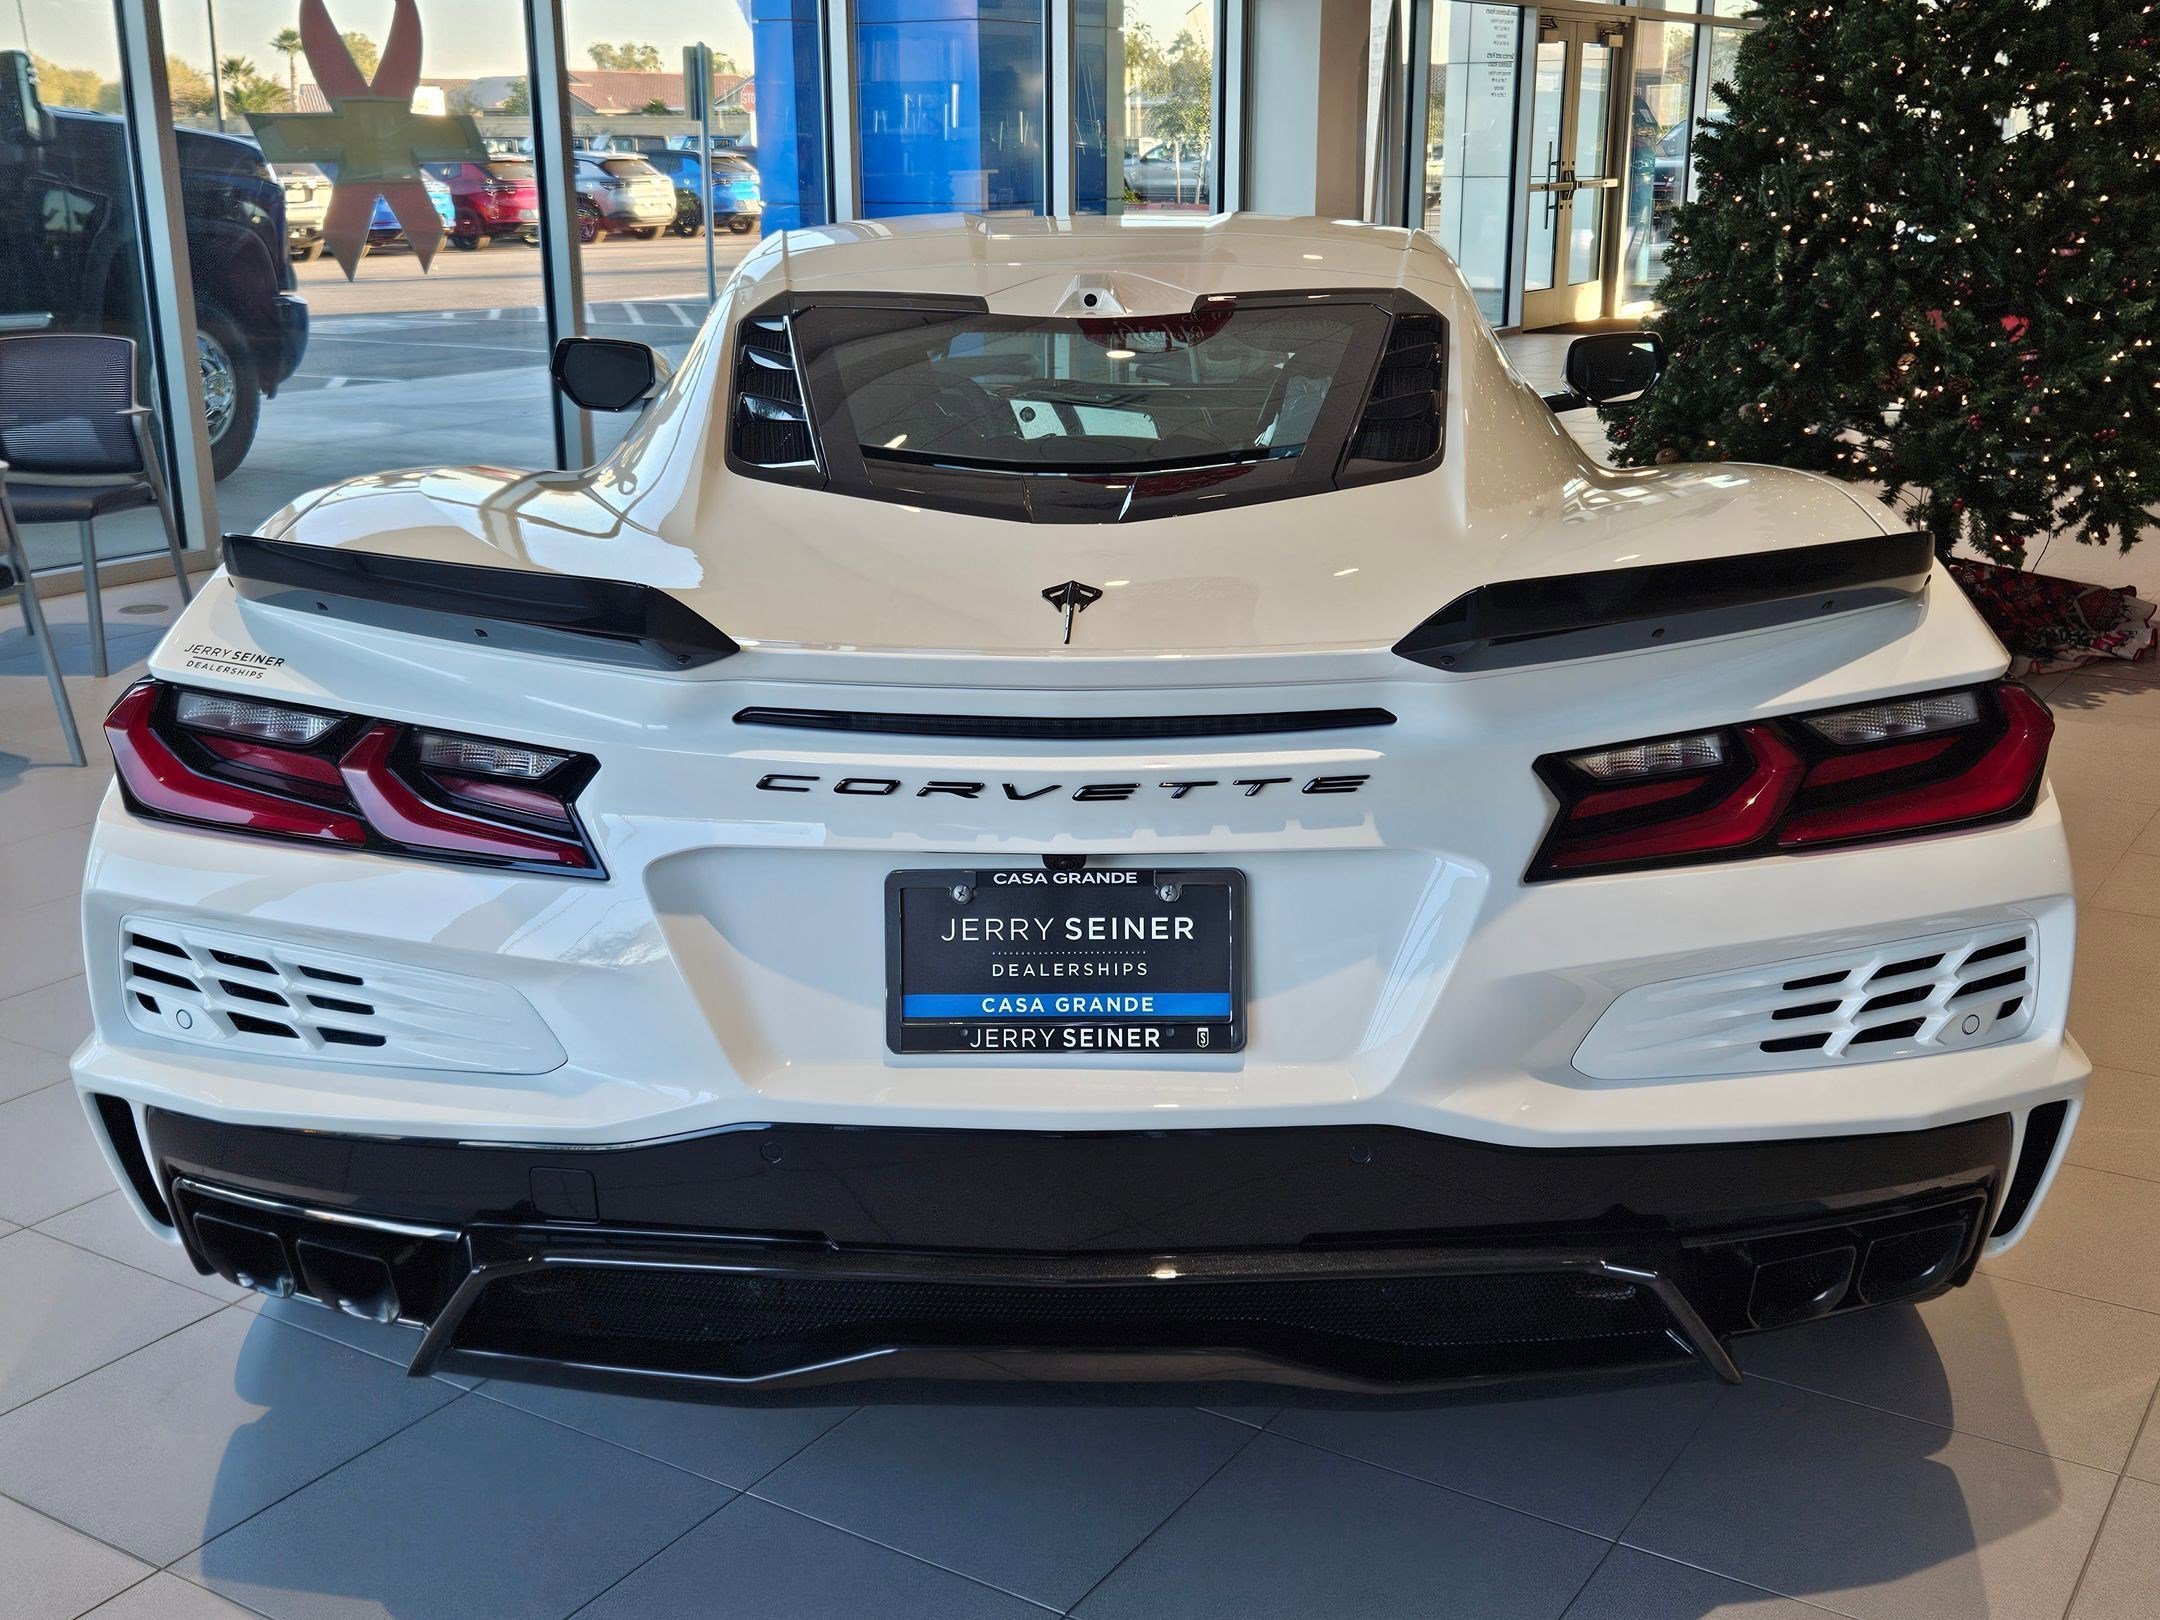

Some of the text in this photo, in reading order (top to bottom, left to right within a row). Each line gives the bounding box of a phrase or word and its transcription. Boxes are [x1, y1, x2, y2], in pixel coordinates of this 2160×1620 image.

[184, 643, 286, 668] JERRY SEINER
[186, 660, 264, 679] DEALERSHIPS
[755, 773, 1371, 802] CORVETTE
[993, 871, 1138, 885] CASA GRANDE
[940, 916, 1195, 942] JERRY SEINER
[992, 962, 1148, 977] DEALERSHIPS
[981, 996, 1154, 1013] CASA GRANDE
[970, 1027, 1160, 1048] JERRY SEINER
